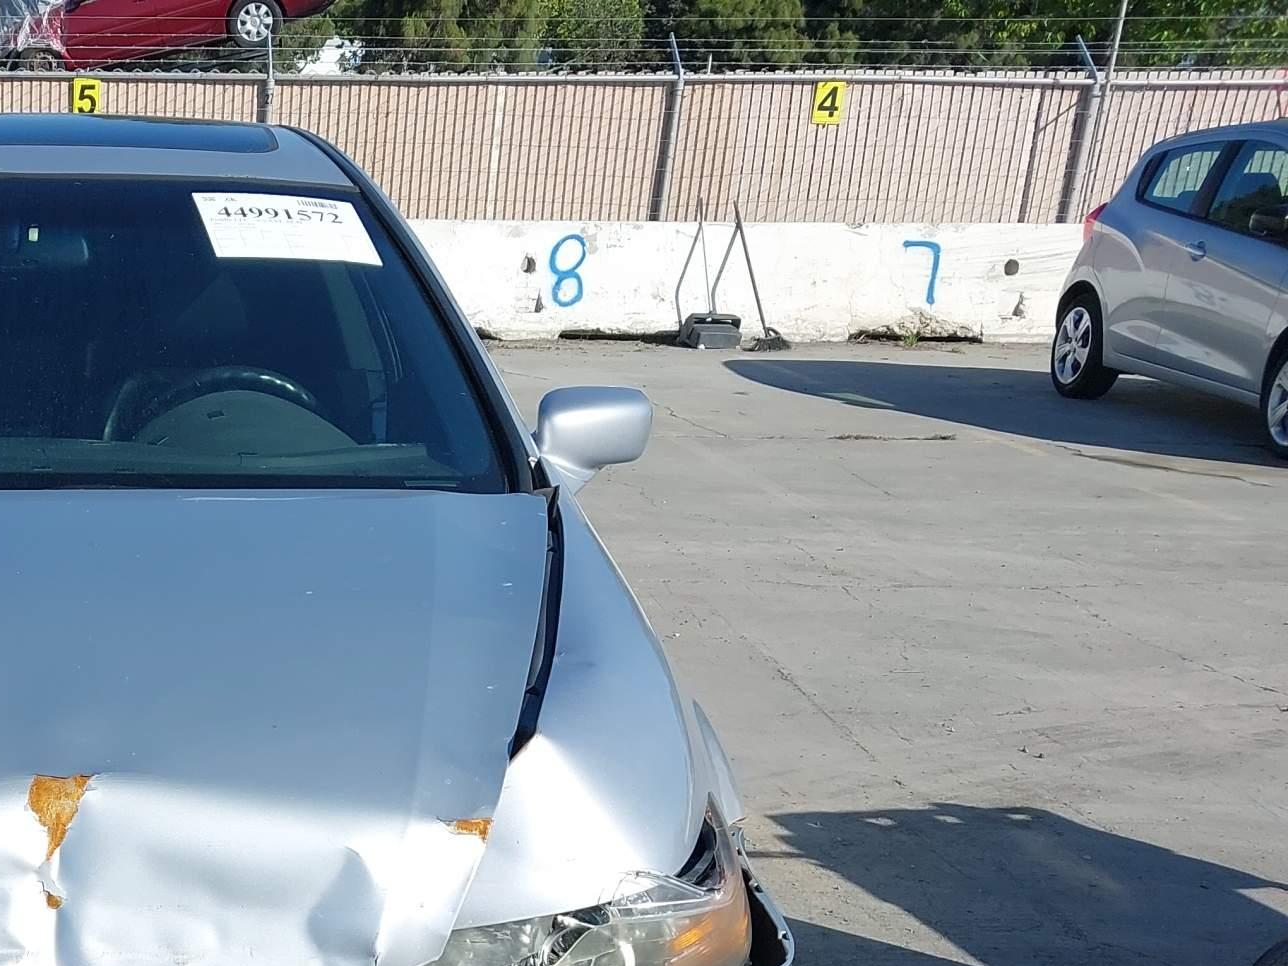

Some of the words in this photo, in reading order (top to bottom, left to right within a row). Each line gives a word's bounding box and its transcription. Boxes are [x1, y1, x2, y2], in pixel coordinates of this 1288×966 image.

[78, 84, 96, 113] 5
[817, 86, 839, 117] 4
[217, 206, 344, 224] 44991572
[549, 234, 587, 308] 8
[902, 240, 941, 305] 7
